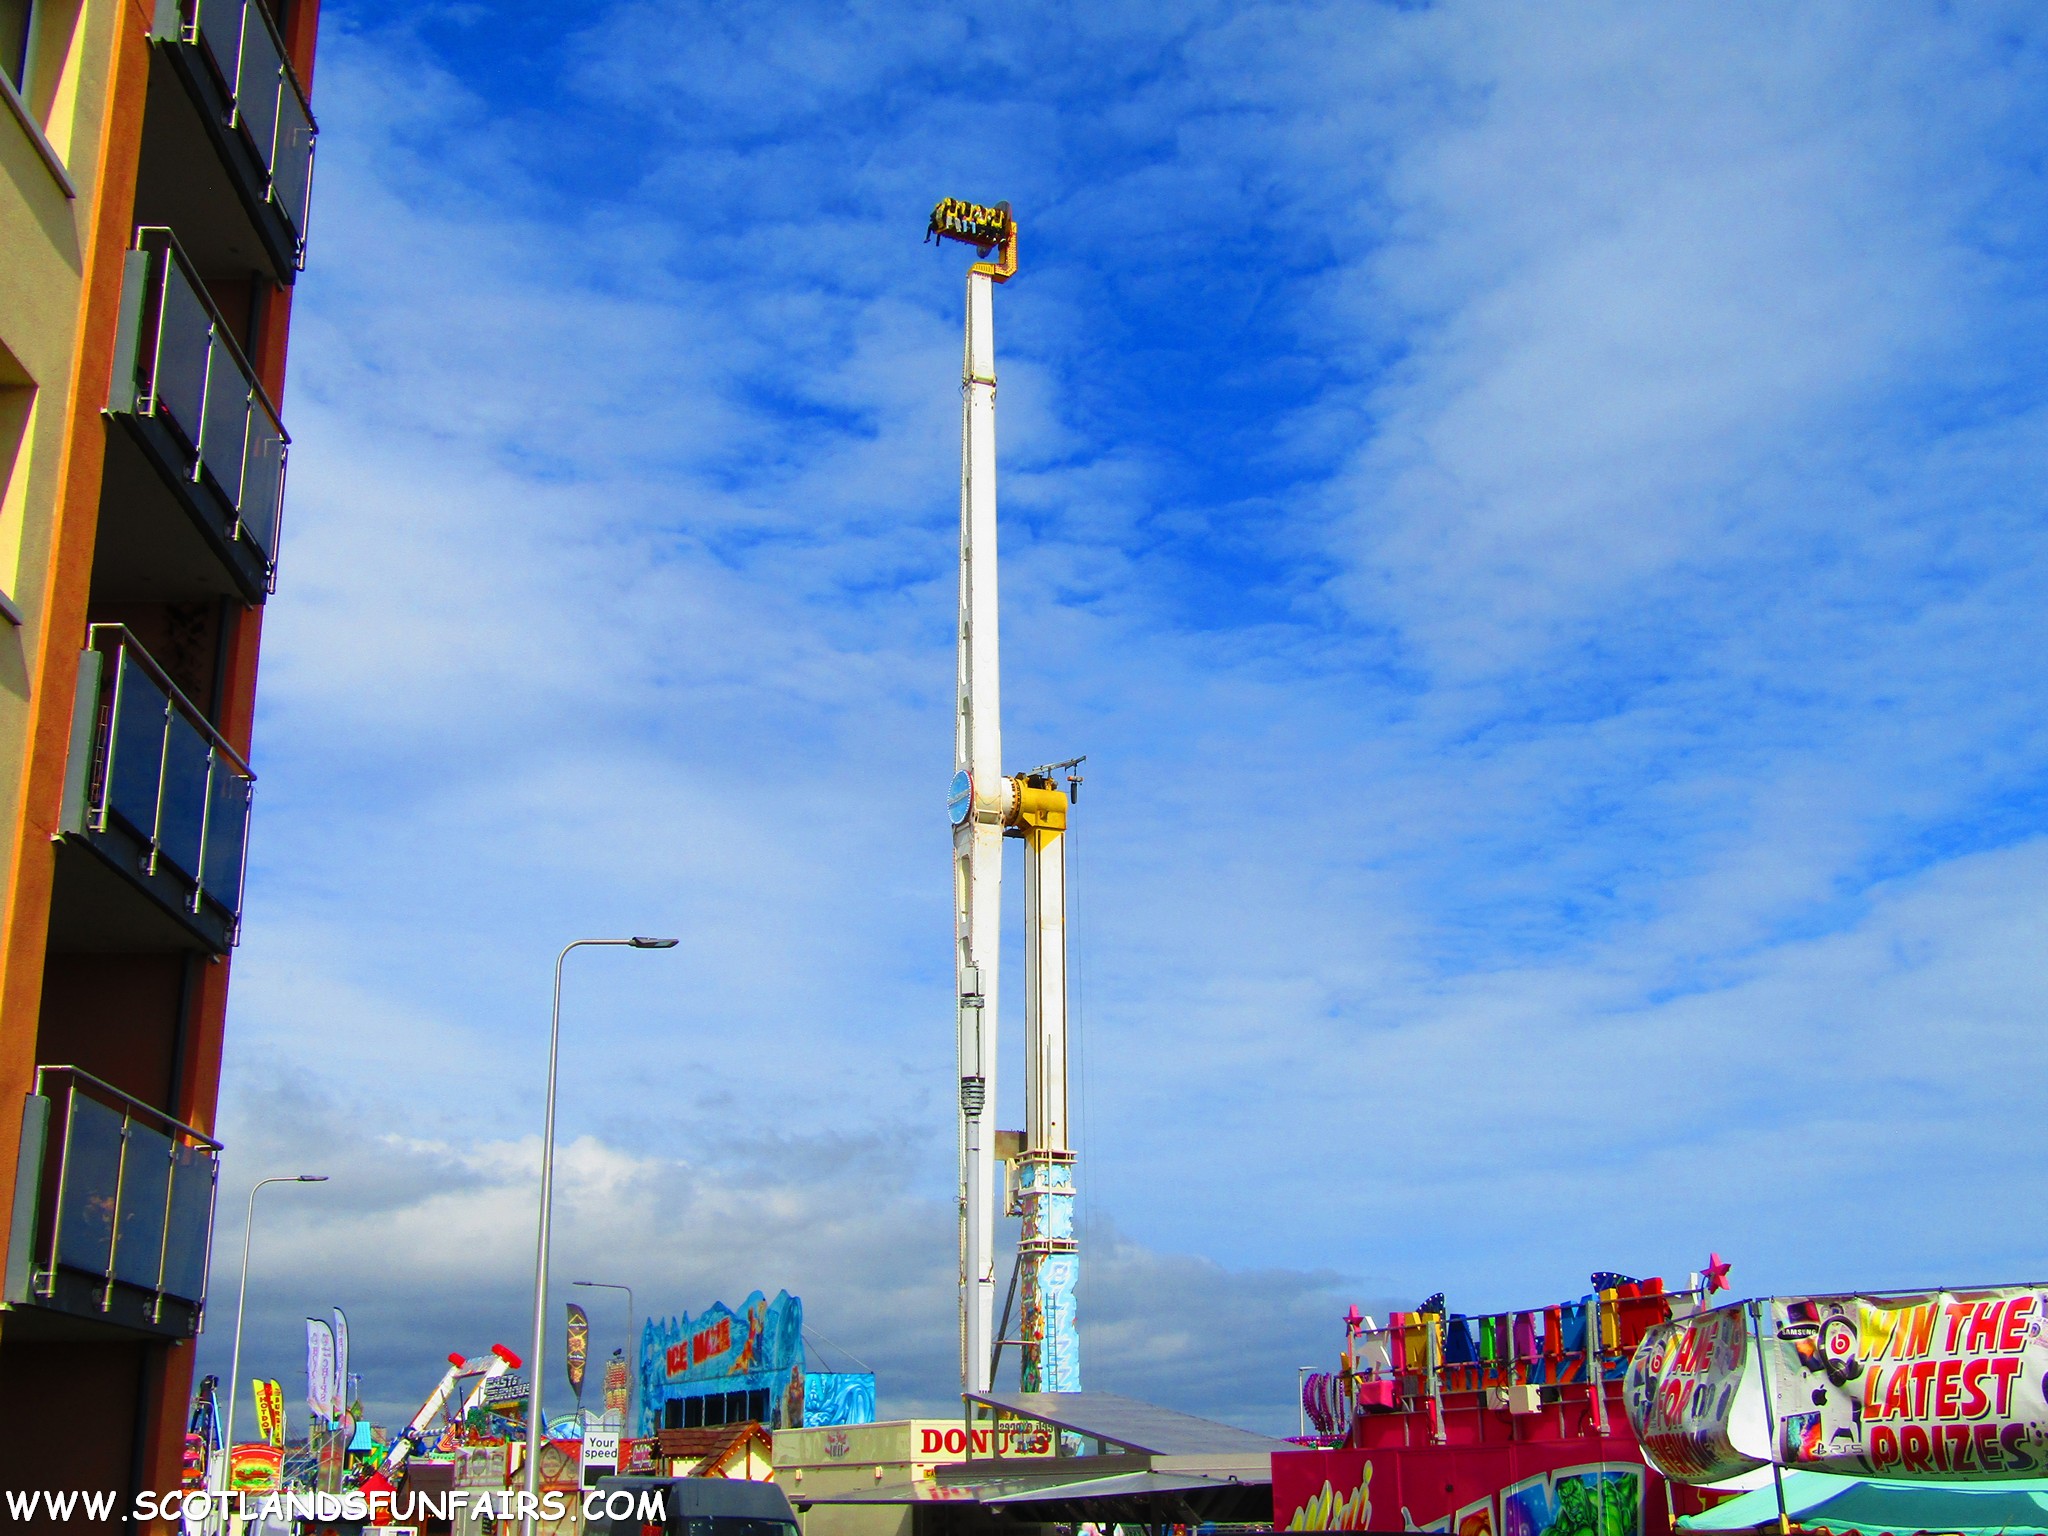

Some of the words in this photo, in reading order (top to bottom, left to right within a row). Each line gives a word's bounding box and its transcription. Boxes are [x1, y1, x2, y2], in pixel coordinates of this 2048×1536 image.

[1781, 1328, 1816, 1337] SAMSUNG
[1858, 1302, 1939, 1360] WIN
[1945, 1297, 2036, 1354] THE
[666, 1340, 688, 1378] ICE
[1657, 1378, 1695, 1430] FOR
[1863, 1357, 2022, 1421] LATEST
[585, 1448, 617, 1460] speed
[589, 1437, 615, 1448] Your
[921, 1429, 1051, 1455] DONUTS
[1870, 1423, 2038, 1474] PRIZES
